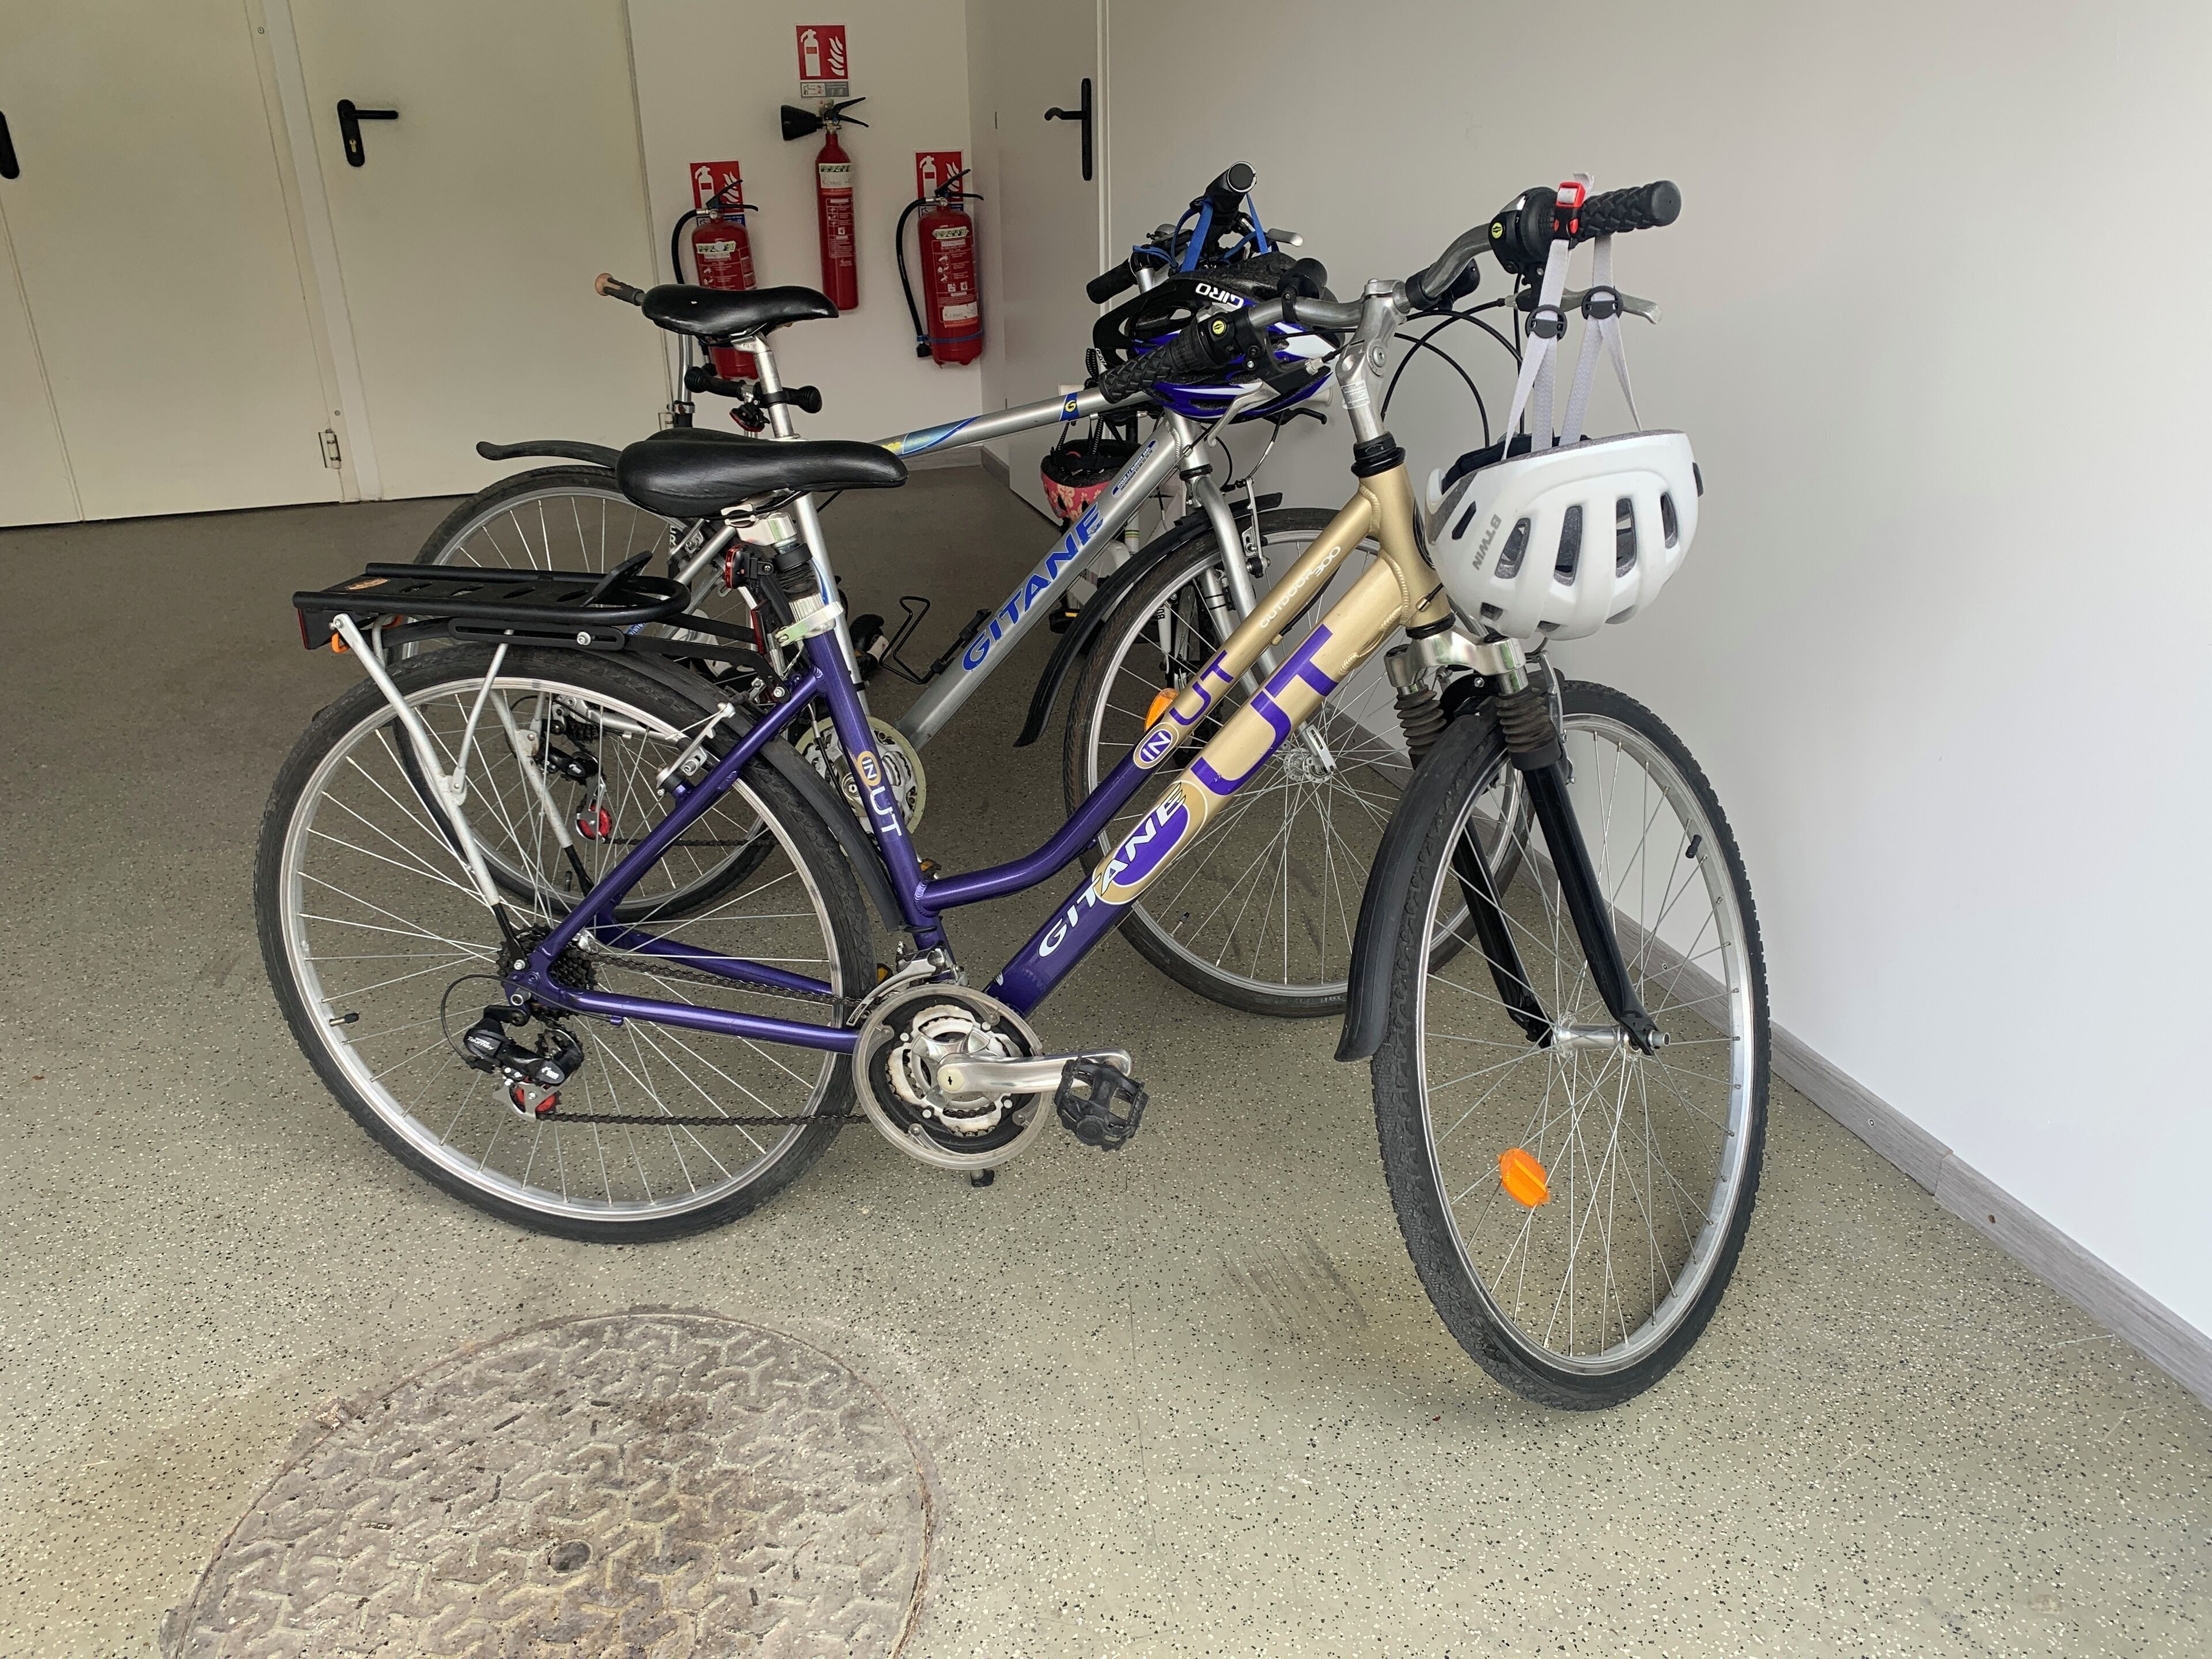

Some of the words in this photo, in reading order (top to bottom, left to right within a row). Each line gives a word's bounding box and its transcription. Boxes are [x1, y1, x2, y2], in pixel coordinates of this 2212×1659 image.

[1195, 282, 1244, 309] GIRO
[962, 502, 1104, 672] GITANE
[1259, 568, 1315, 628] OUTDOOR
[1315, 546, 1341, 577] 300
[1142, 731, 1172, 760] IN
[862, 759, 877, 779] IN
[1039, 782, 1187, 957] GITANE
[467, 1036, 495, 1050] Tourney
